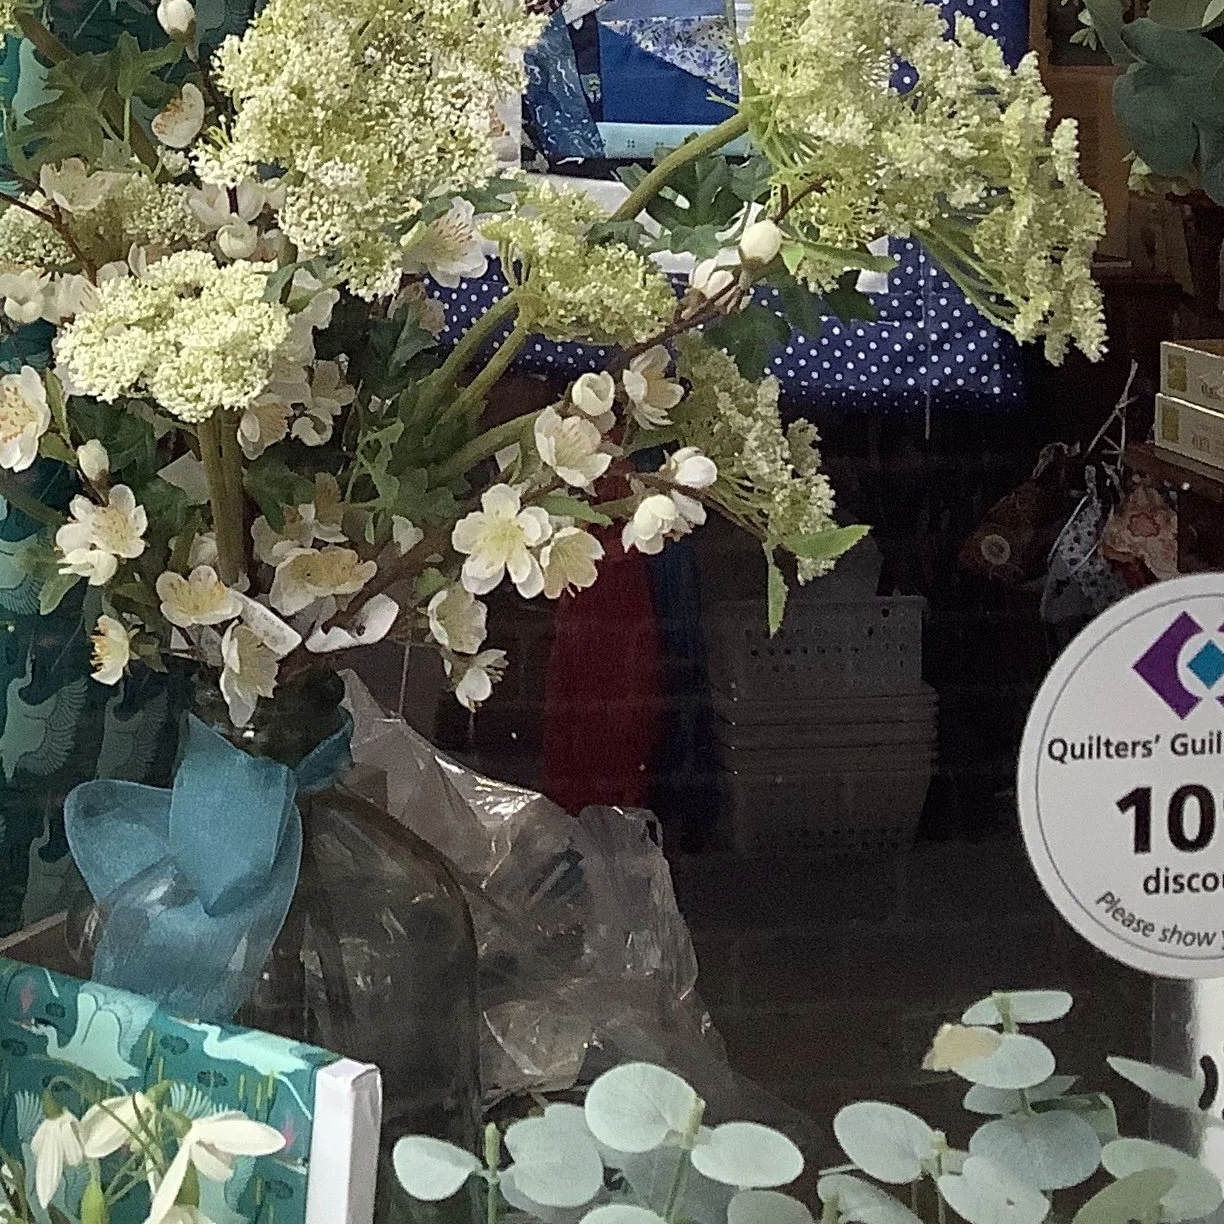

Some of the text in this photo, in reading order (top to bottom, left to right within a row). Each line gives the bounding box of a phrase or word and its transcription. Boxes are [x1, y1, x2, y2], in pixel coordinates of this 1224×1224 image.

[1170, 730, 1222, 757] Guil
[1116, 783, 1224, 855] 10
[1142, 866, 1224, 896] disco
[1096, 890, 1156, 938] Please
[1158, 924, 1217, 948] show
